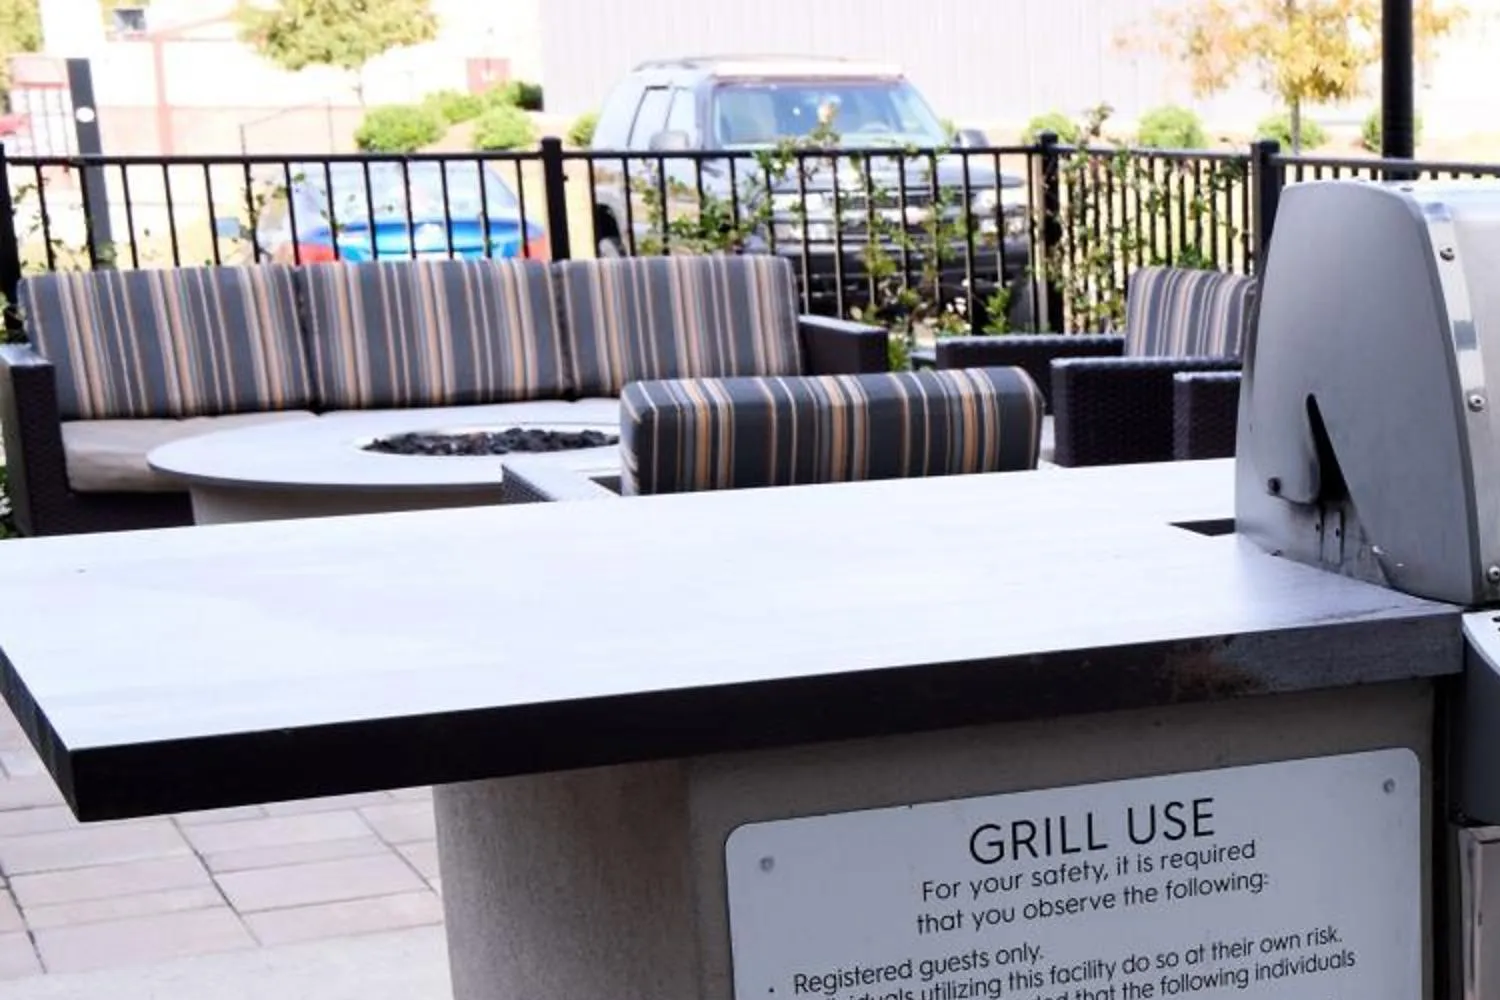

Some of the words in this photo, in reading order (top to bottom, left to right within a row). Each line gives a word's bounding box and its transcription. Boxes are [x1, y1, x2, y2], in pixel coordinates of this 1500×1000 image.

[969, 811, 1109, 866] GRILL
[1127, 796, 1216, 846] USE
[916, 908, 965, 935] that
[971, 906, 1016, 932] you
[1022, 892, 1117, 921] observe
[1122, 884, 1159, 907] the
[1164, 871, 1269, 901] following:
[922, 879, 962, 903] For
[969, 872, 1024, 901] your
[1031, 859, 1109, 888] safety,
[1115, 855, 1130, 877] it
[1136, 852, 1154, 873] is
[1159, 839, 1256, 871] required
[793, 958, 914, 997] Registered
[918, 949, 991, 983] guests
[995, 941, 1045, 966] only.
[1007, 968, 1045, 992] this
[1048, 959, 1117, 986] facility
[1121, 953, 1151, 976] do
[1155, 951, 1180, 970] so
[1184, 943, 1206, 966] at
[1211, 937, 1255, 961] their
[1259, 933, 1301, 955] own
[1306, 925, 1343, 947] risk.
[1159, 967, 1249, 997] following
[1254, 948, 1356, 981] individuals
